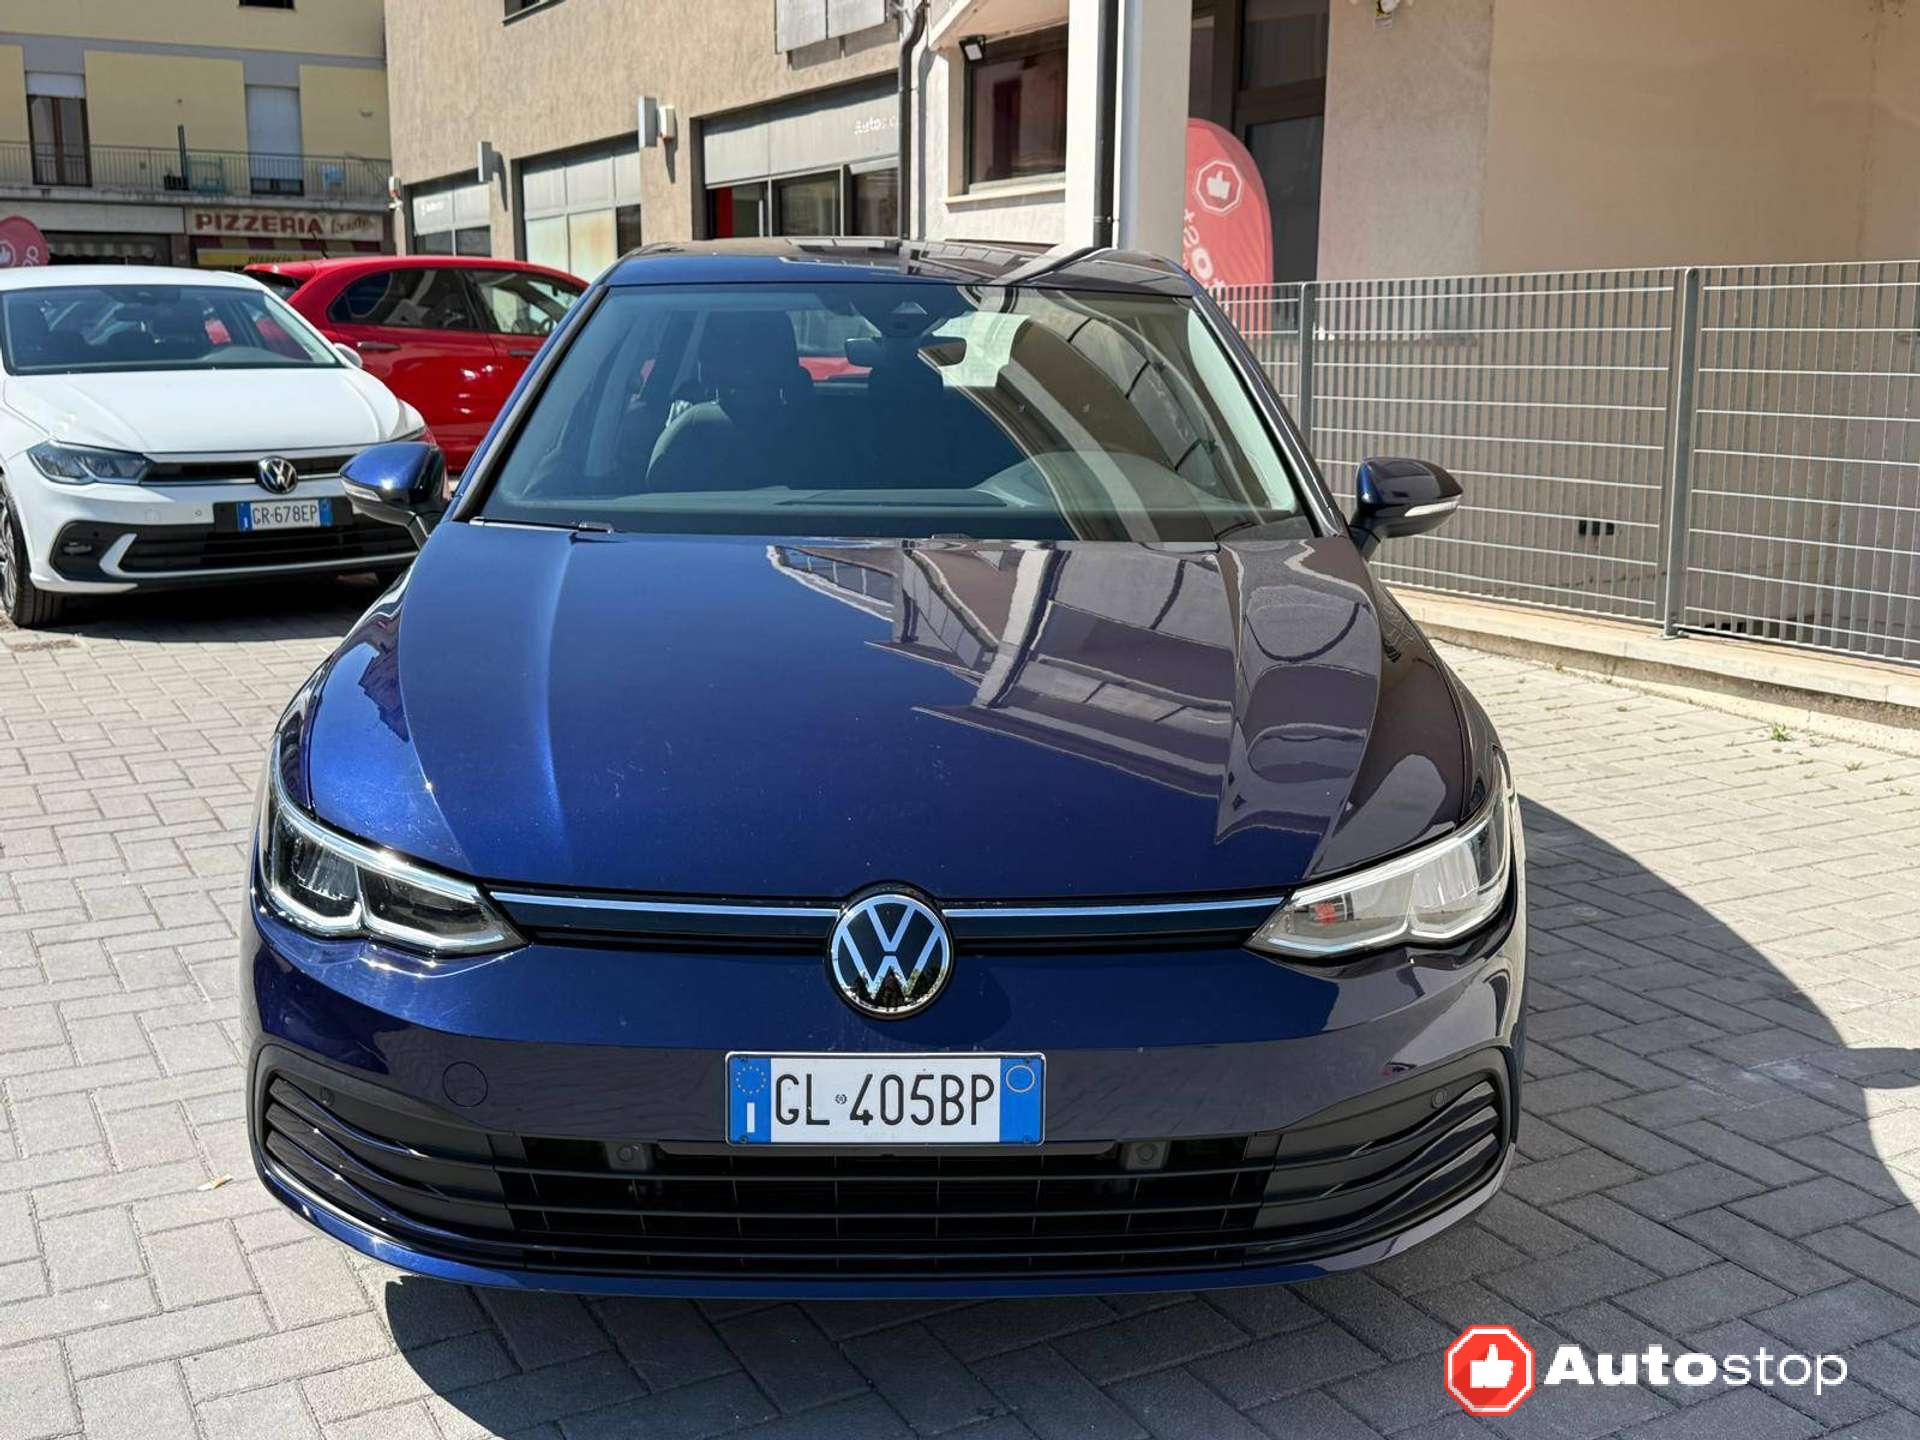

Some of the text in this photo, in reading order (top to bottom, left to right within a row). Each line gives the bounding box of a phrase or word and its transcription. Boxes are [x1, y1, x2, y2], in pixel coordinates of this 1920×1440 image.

[195, 213, 323, 234] PIZZERIA
[775, 1073, 830, 1126] GL
[849, 1073, 994, 1126] 405BP
